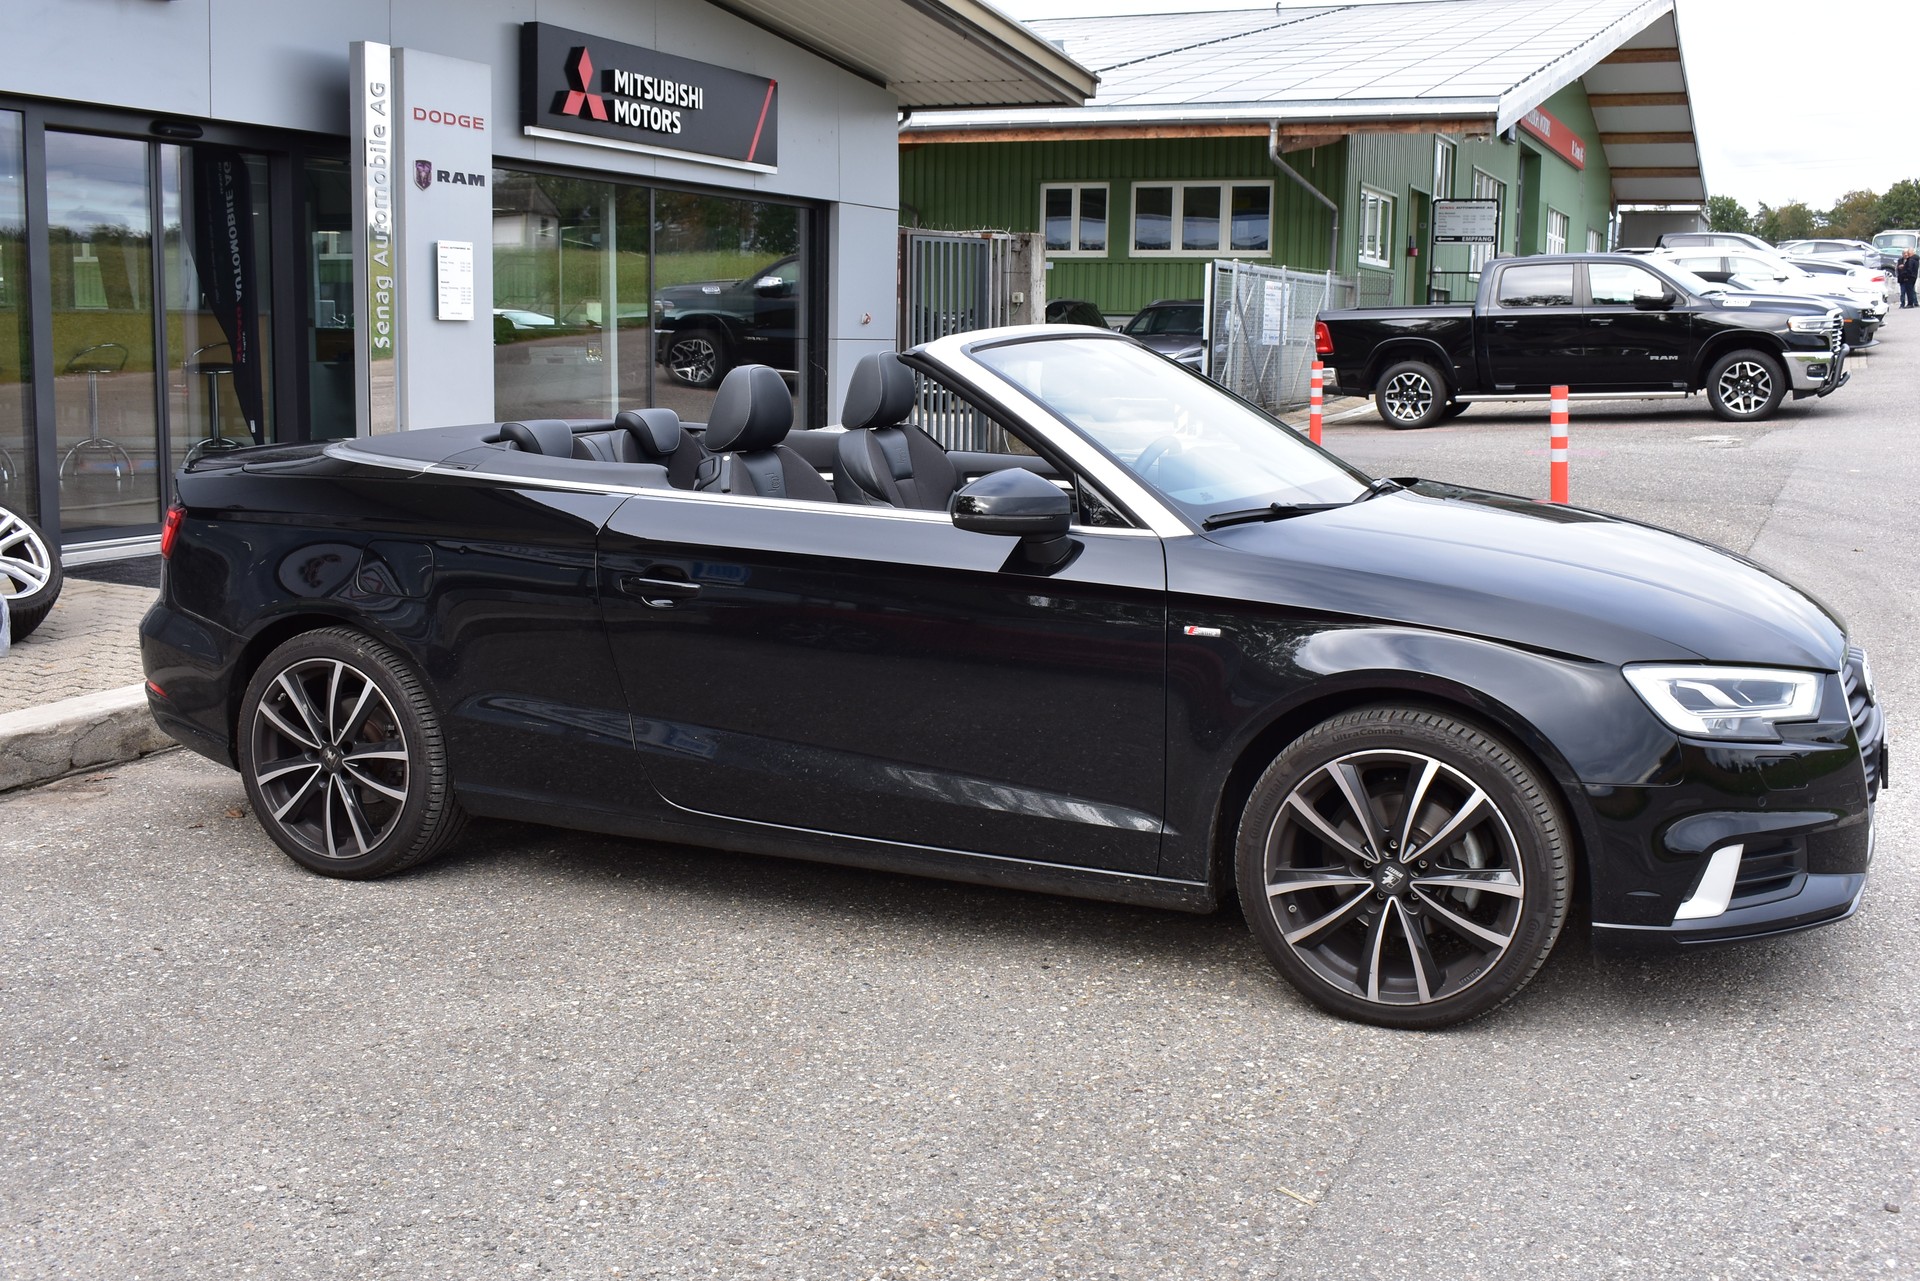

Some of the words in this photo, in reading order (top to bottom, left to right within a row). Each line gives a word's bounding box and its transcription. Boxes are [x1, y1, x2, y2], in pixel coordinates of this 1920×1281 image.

[370, 82, 386, 116] AG
[614, 68, 703, 110] MITSUBISHI
[413, 107, 485, 130] DODGE
[614, 98, 682, 134] MOTORS
[369, 124, 389, 267] Automobile
[436, 169, 486, 187] RAM
[374, 275, 393, 348] Senag
[1332, 728, 1404, 742] UltraContact
[1249, 776, 1284, 839] Continental
[1502, 918, 1540, 978] Continental
